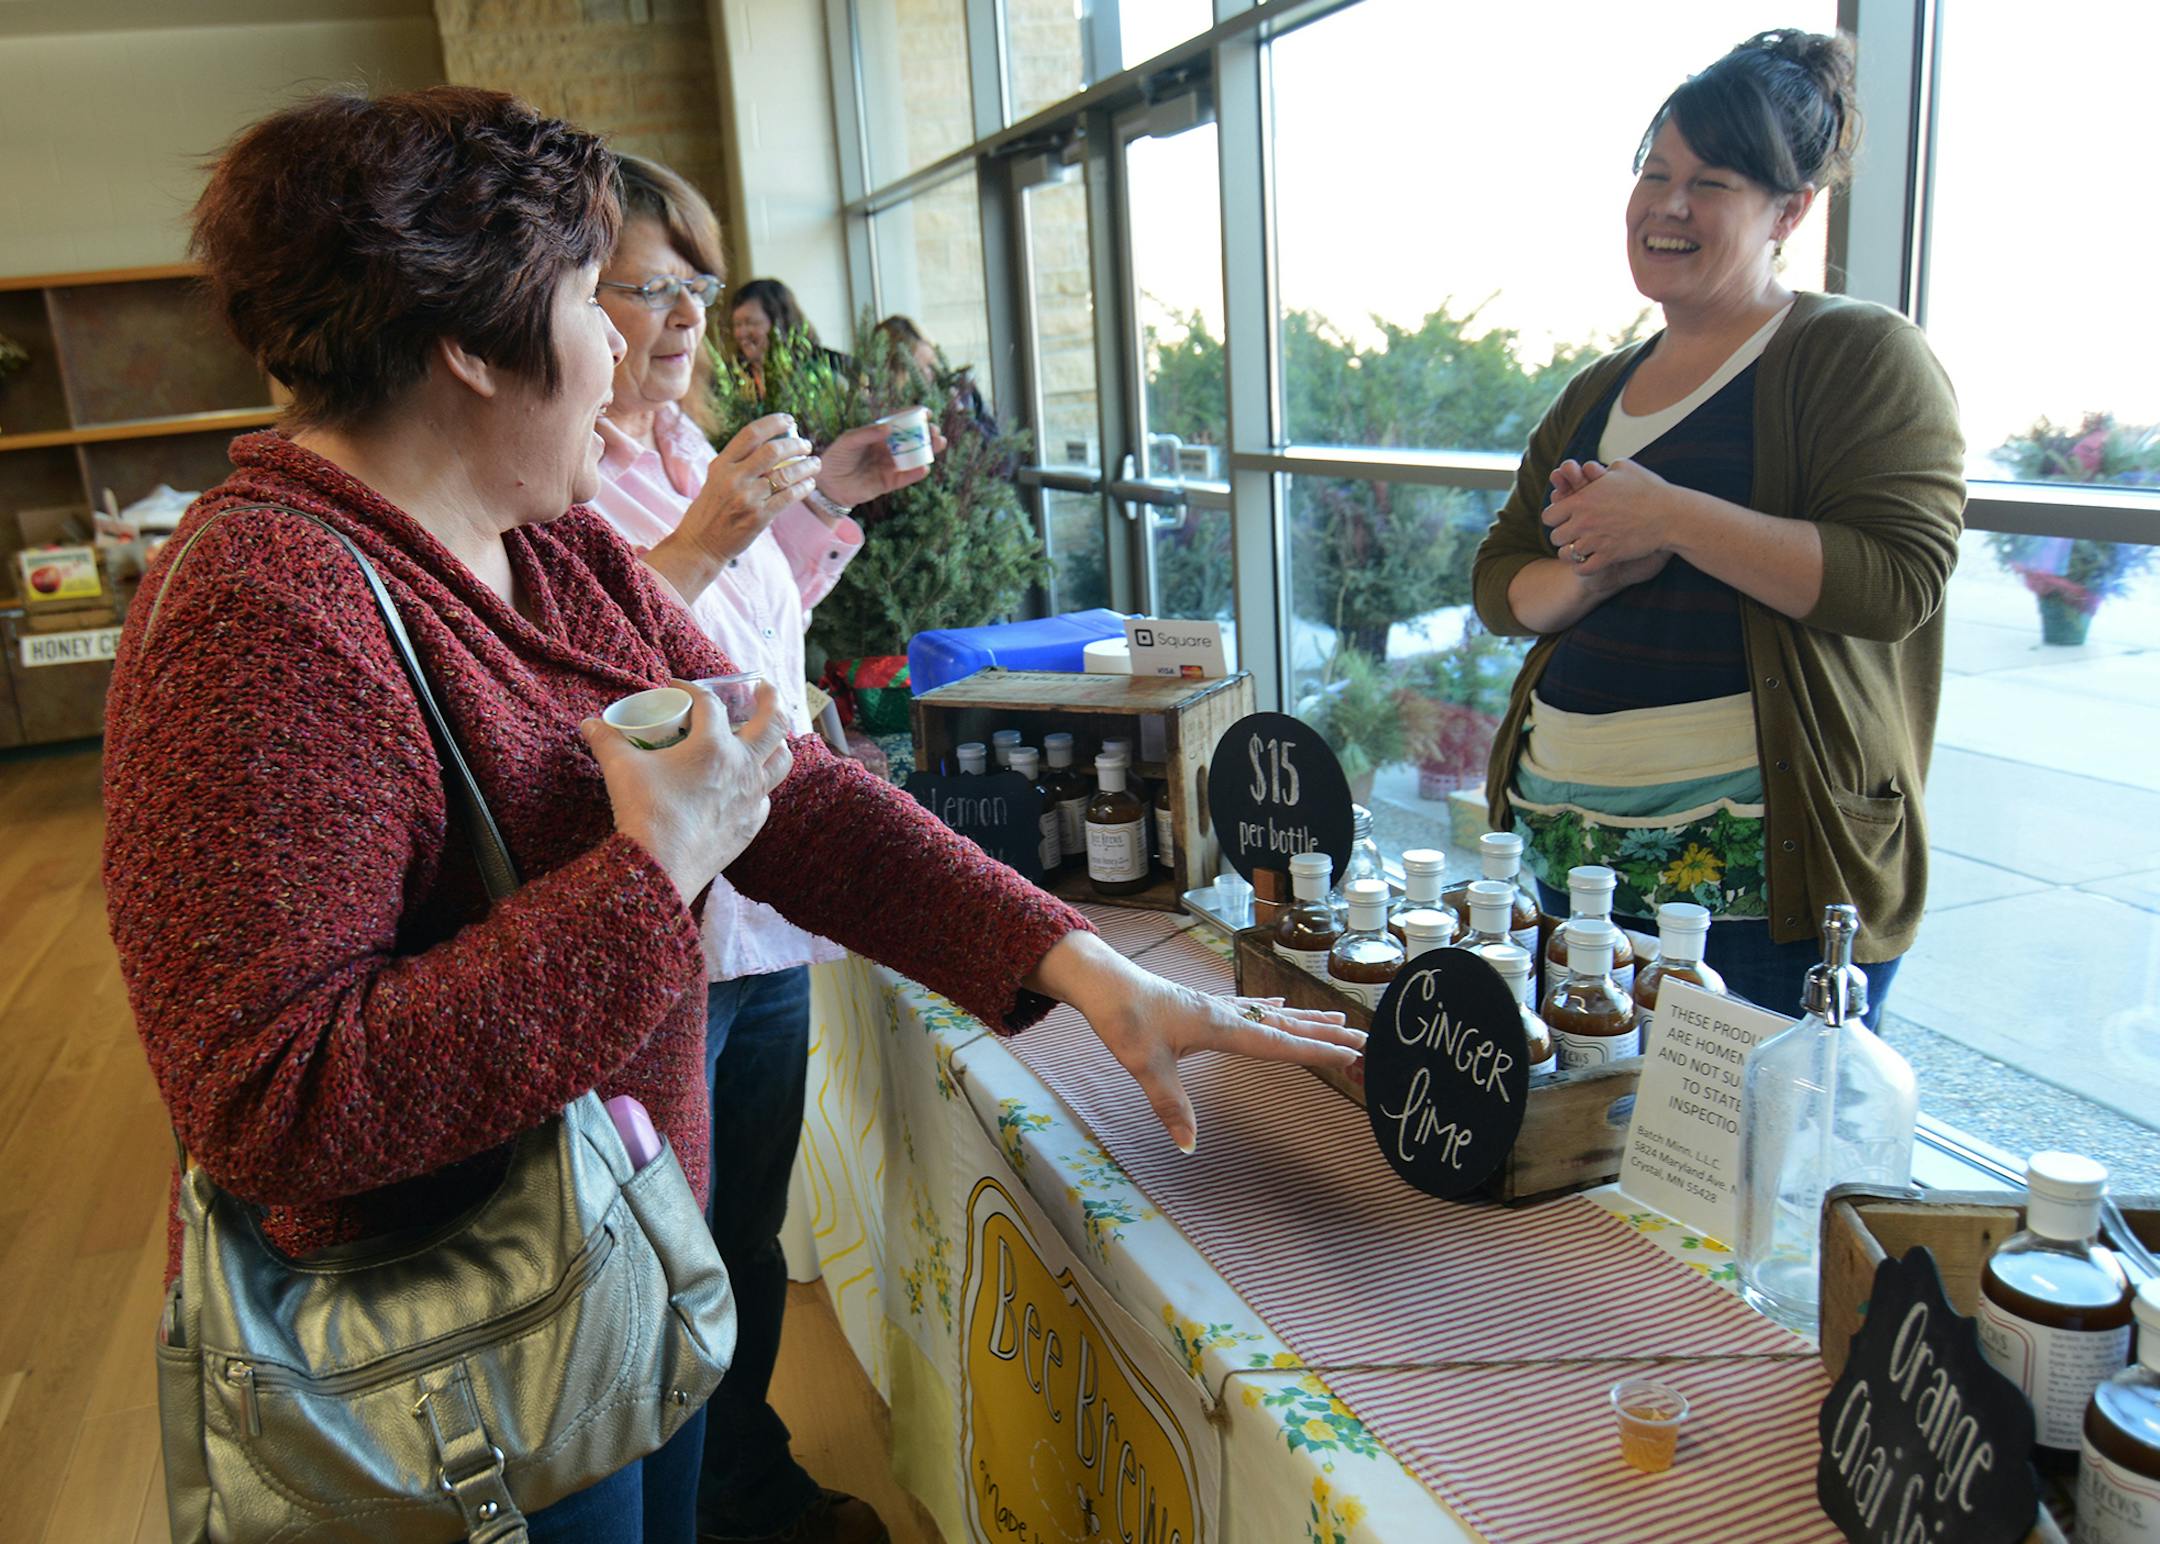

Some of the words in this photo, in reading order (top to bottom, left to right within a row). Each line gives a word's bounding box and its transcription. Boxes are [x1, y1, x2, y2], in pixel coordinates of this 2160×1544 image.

[32, 637, 93, 660] HONEY
[1157, 631, 1212, 649] Square
[1248, 732, 1300, 807] $15
[1239, 820, 1266, 855] per
[1268, 816, 1319, 856] bottle
[1667, 1027, 1693, 1047] ARE
[1671, 1004, 1711, 1031] THESE
[1658, 1047, 1688, 1067] AND
[1689, 1058, 1720, 1079] NOT
[1682, 1076, 1701, 1096] TO
[1703, 1086, 1742, 1113] STATE
[1637, 1125, 1664, 1144] Batch
[1668, 1095, 1740, 1137] INSPECTIO
[1630, 1155, 1664, 1180] Crystal,
[1666, 1172, 1685, 1188] MN
[1686, 1181, 1718, 1204] 55428
[1634, 1140, 1657, 1158] 5824
[1659, 1151, 1705, 1180] Maryland
[989, 1234, 1063, 1423] Bee
[1075, 1330, 1182, 1544] Brew
[1889, 1301, 1994, 1512] Orange
[1831, 1379, 1903, 1530] Chai
